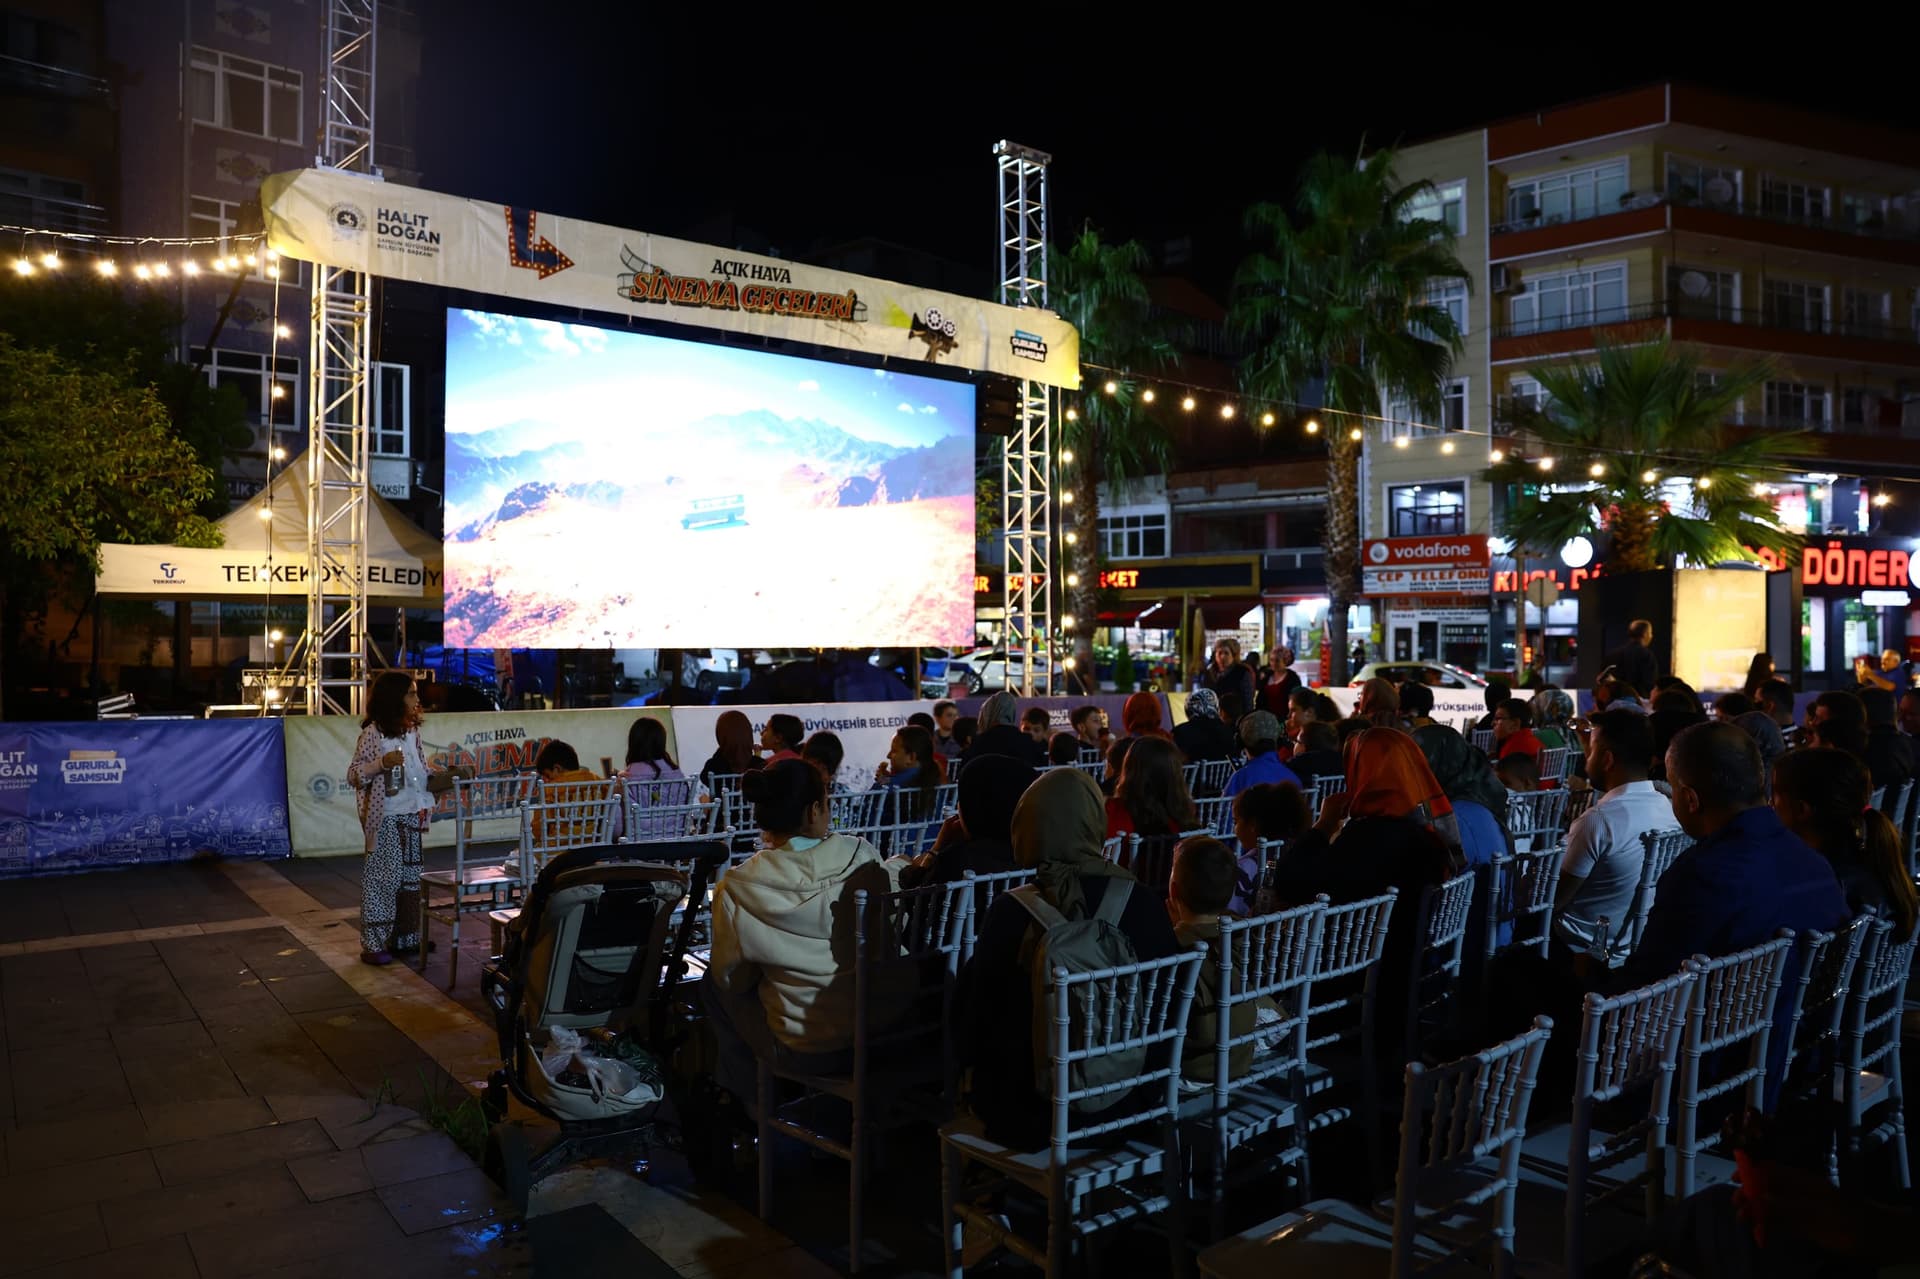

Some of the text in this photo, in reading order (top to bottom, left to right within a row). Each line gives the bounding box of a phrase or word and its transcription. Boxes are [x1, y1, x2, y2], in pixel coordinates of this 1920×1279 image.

[377, 222, 440, 245] DOĞAN
[711, 259, 792, 284] AÇIK HAVA
[630, 266, 857, 319] SİNEMA GECELERİ
[1394, 542, 1471, 559] vodafone
[1802, 541, 1910, 587] DÖNER
[357, 565, 443, 587] ELEDİY
[1377, 572, 1404, 582] CEP
[1411, 569, 1489, 582] TELEFONU
[464, 728, 526, 746] AÇIK HAVA
[65, 759, 121, 770] GURURLA
[70, 772, 119, 783] SAMSUN
